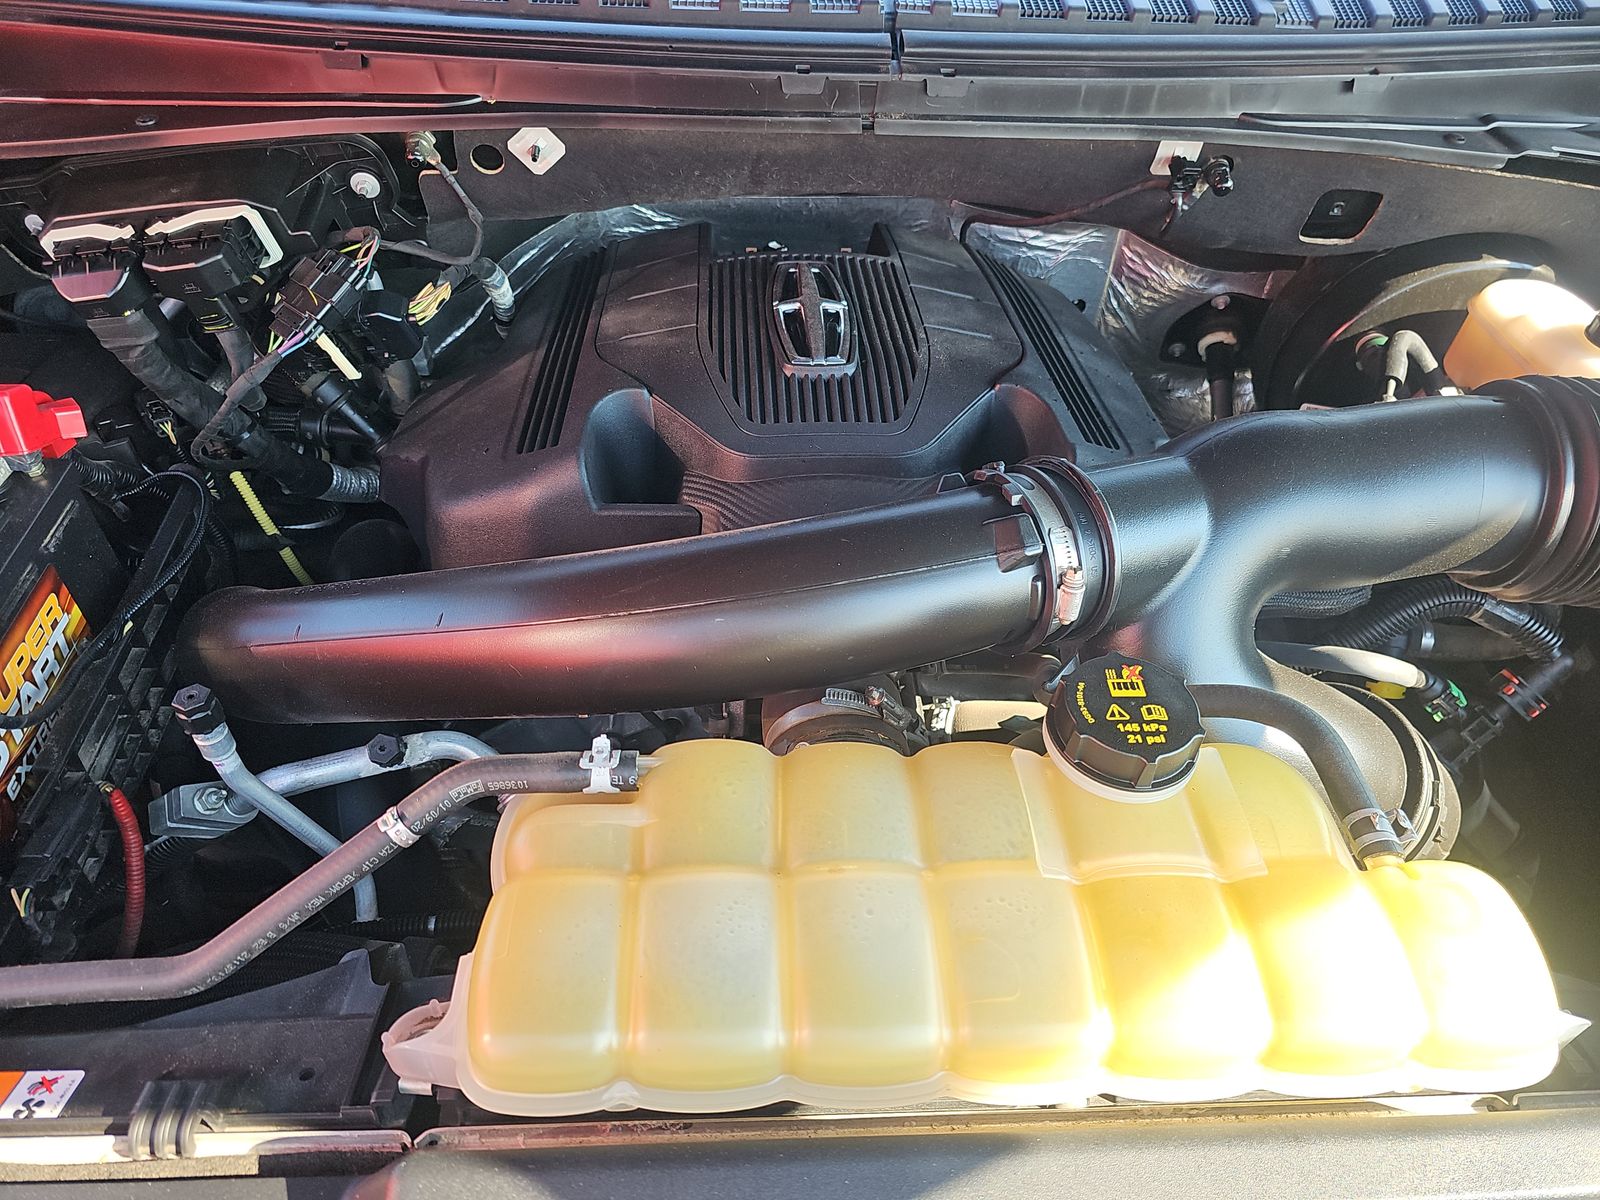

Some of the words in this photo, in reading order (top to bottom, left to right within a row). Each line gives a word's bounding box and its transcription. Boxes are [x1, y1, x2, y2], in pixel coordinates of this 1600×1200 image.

[0, 592, 64, 714] UPER
[1117, 723, 1140, 732] 145
[1142, 723, 1168, 732] kPa
[1127, 734, 1143, 744] 21
[1146, 734, 1166, 745] psi
[451, 780, 484, 799] FoMoCo
[487, 780, 529, 791] 1036865
[410, 799, 452, 833] 01/09/20
